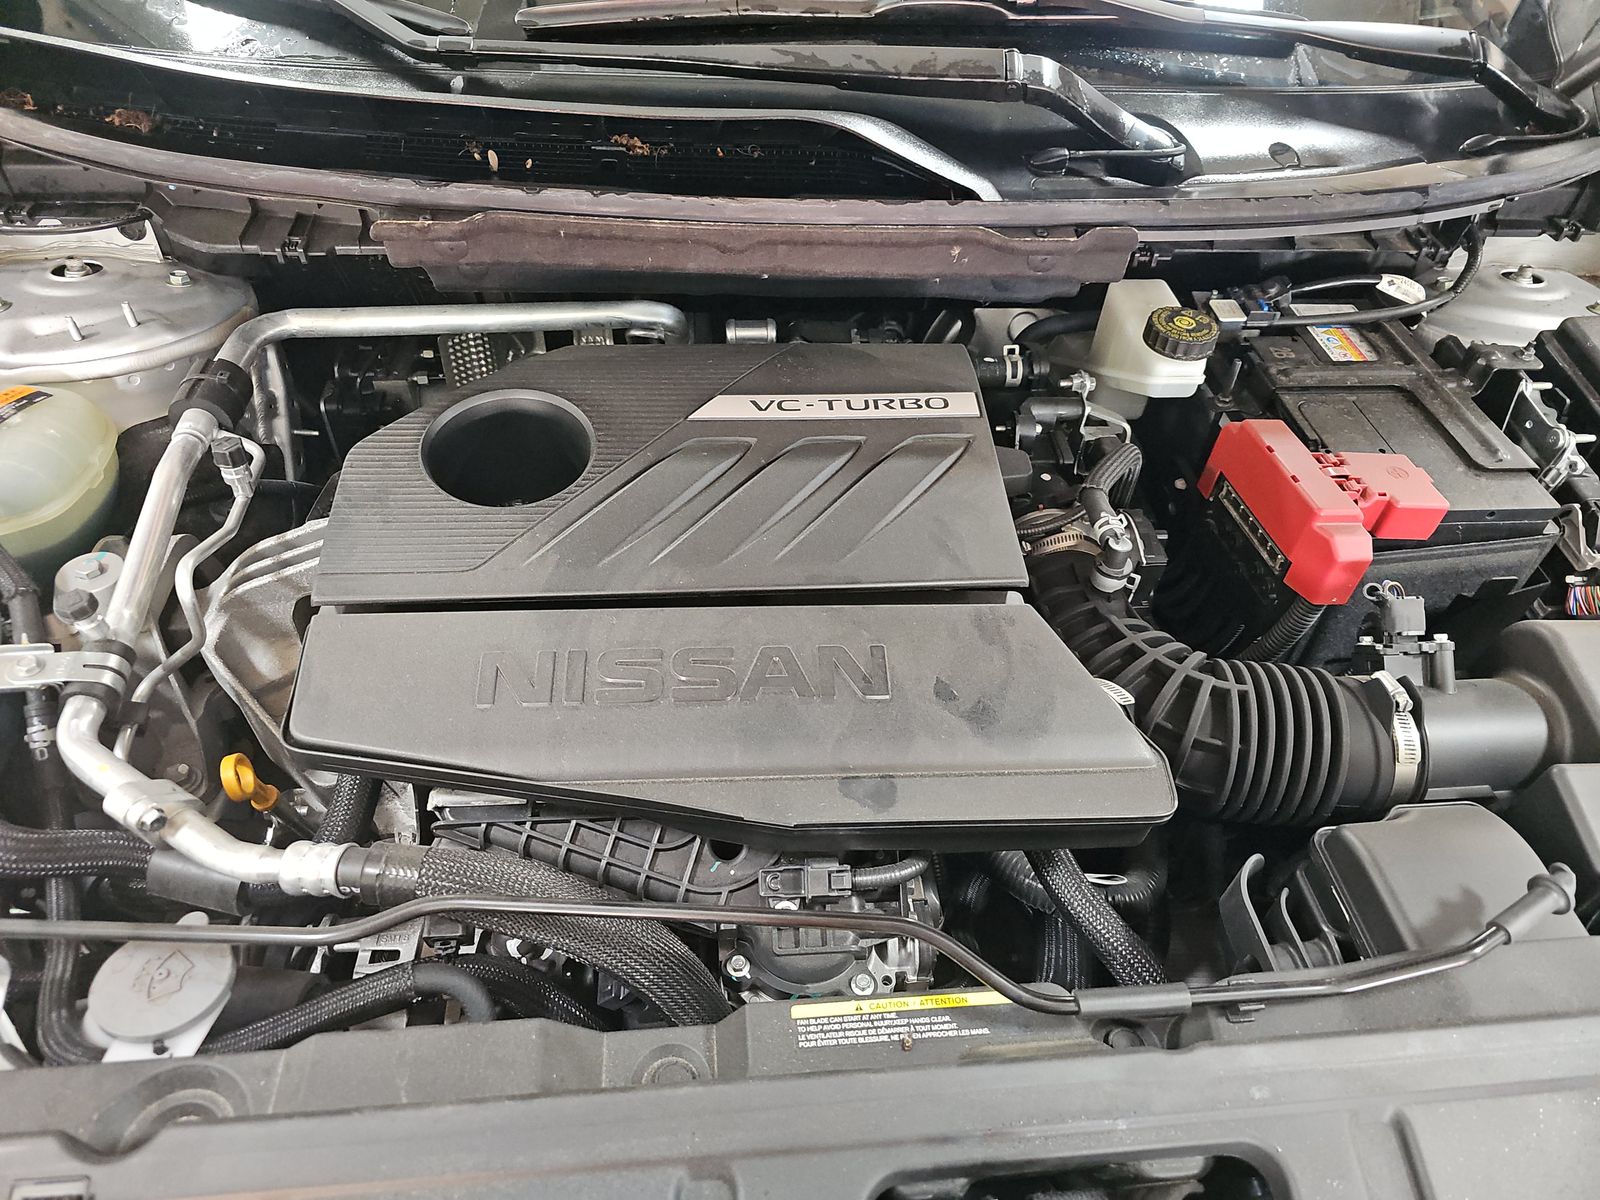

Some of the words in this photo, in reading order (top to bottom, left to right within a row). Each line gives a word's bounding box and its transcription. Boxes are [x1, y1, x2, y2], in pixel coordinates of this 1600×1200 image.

[748, 396, 950, 413] VC-TURBO
[474, 643, 892, 709] NISSAN
[868, 1001, 909, 1011] CAUTION
[919, 997, 968, 1006] ATTENTION
[841, 1021, 873, 1029] PERSONAL
[806, 1031, 845, 1040] VENTILATEUR
[838, 1037, 857, 1045] TOUTE
[921, 1030, 958, 1038] APPROCHER
